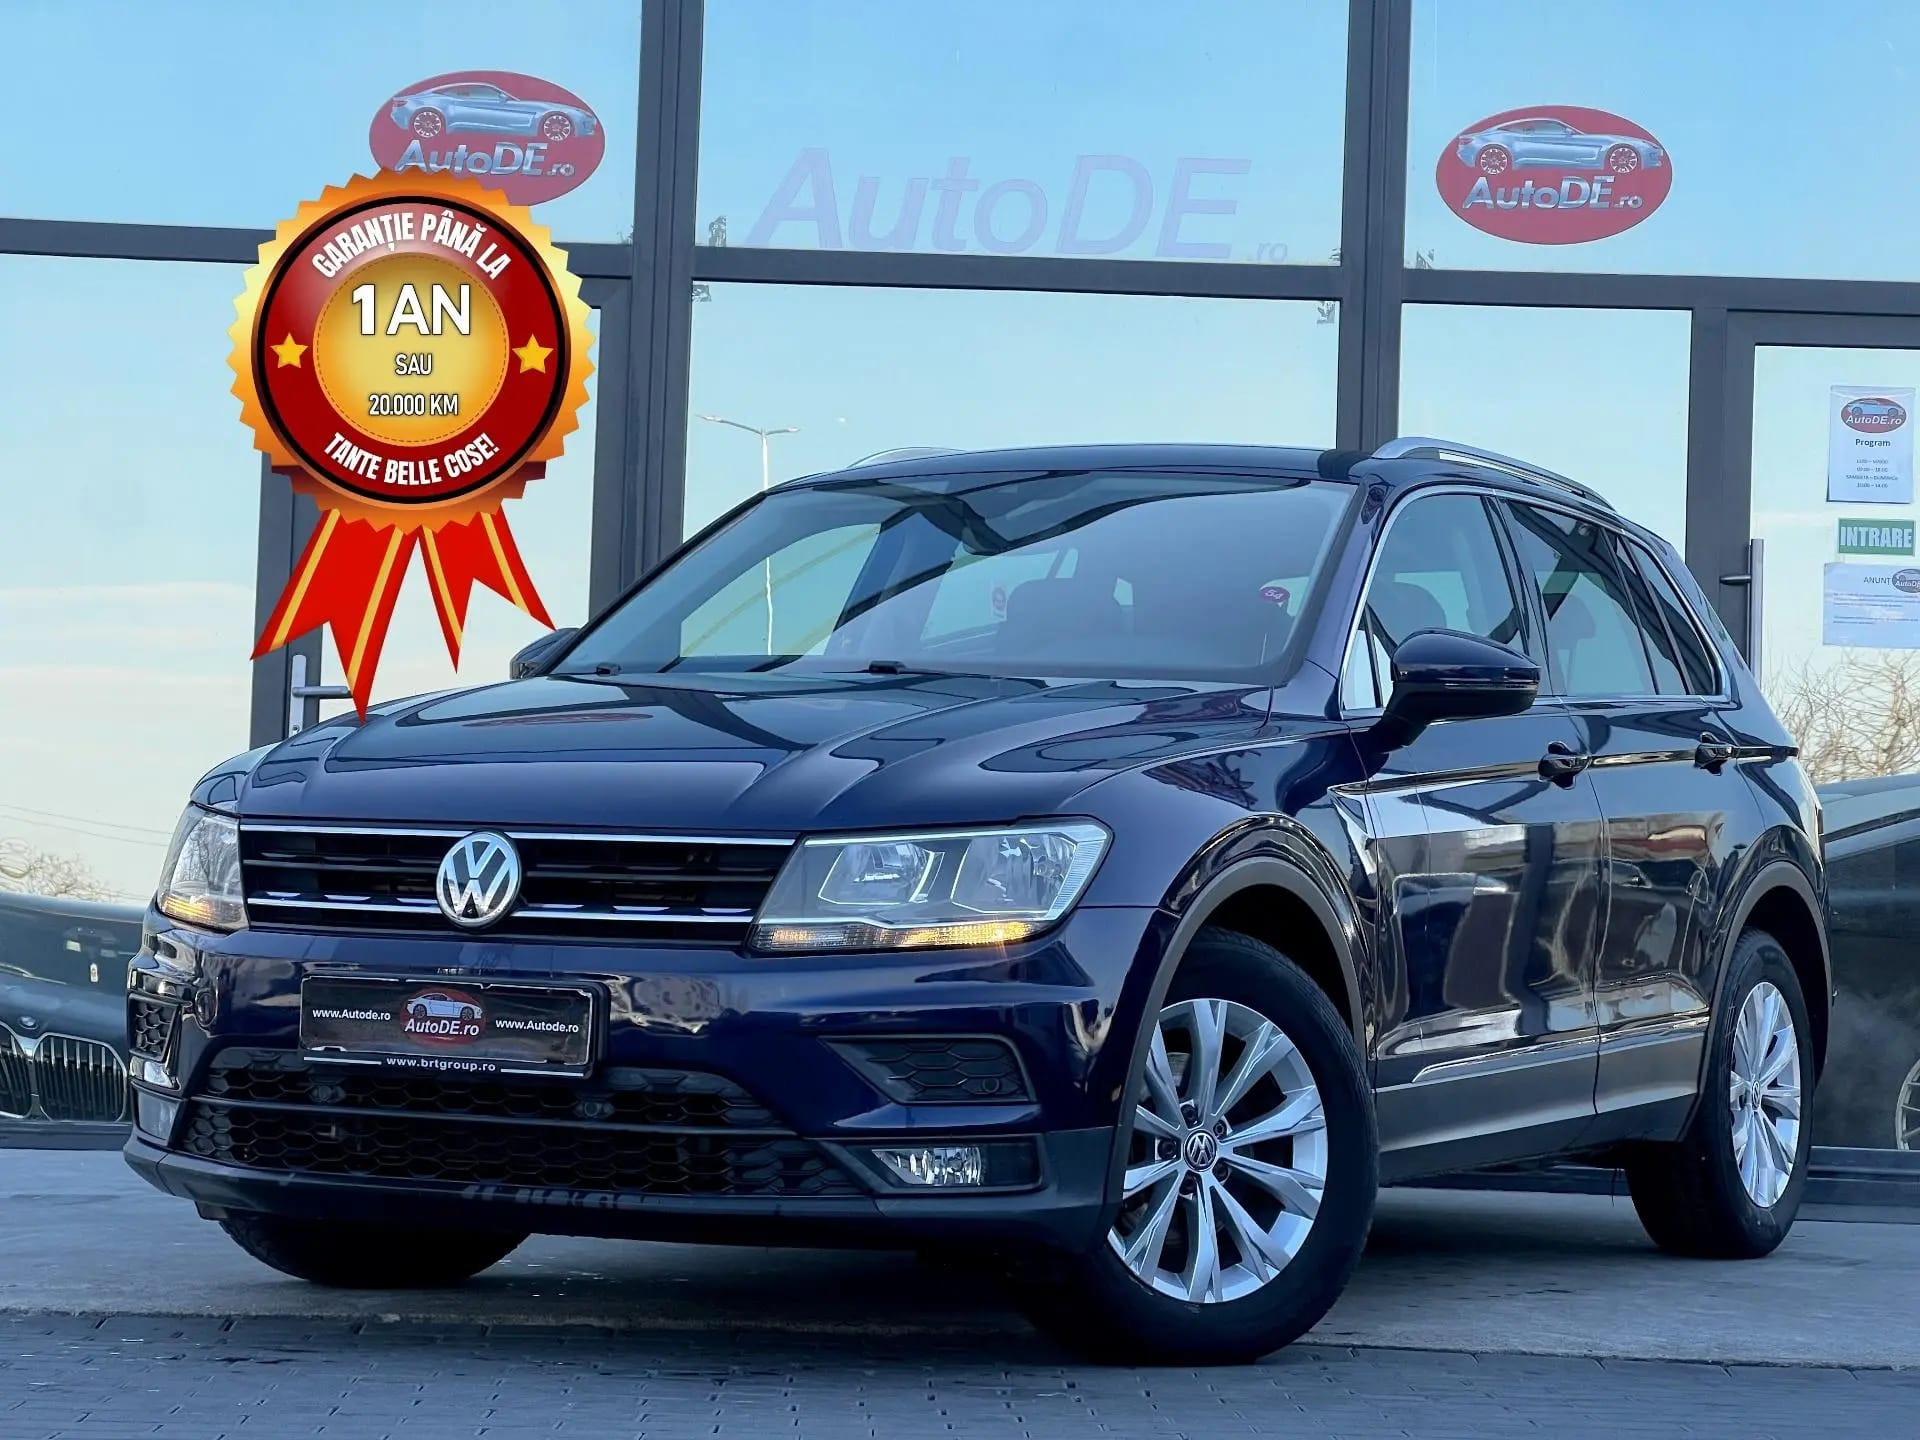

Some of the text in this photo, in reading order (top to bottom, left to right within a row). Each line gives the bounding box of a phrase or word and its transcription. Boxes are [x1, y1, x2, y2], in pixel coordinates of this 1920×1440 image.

[1845, 415, 1902, 425] AutoDE.ro
[1855, 438, 1891, 448] Program
[1840, 526, 1913, 548] INTRARE
[312, 1008, 391, 1021] www.Autode.ro
[404, 1018, 480, 1036] AutoDE.ro
[495, 1019, 579, 1033] www.Autode.ro
[386, 1056, 496, 1072] www.brtgroup.ro
